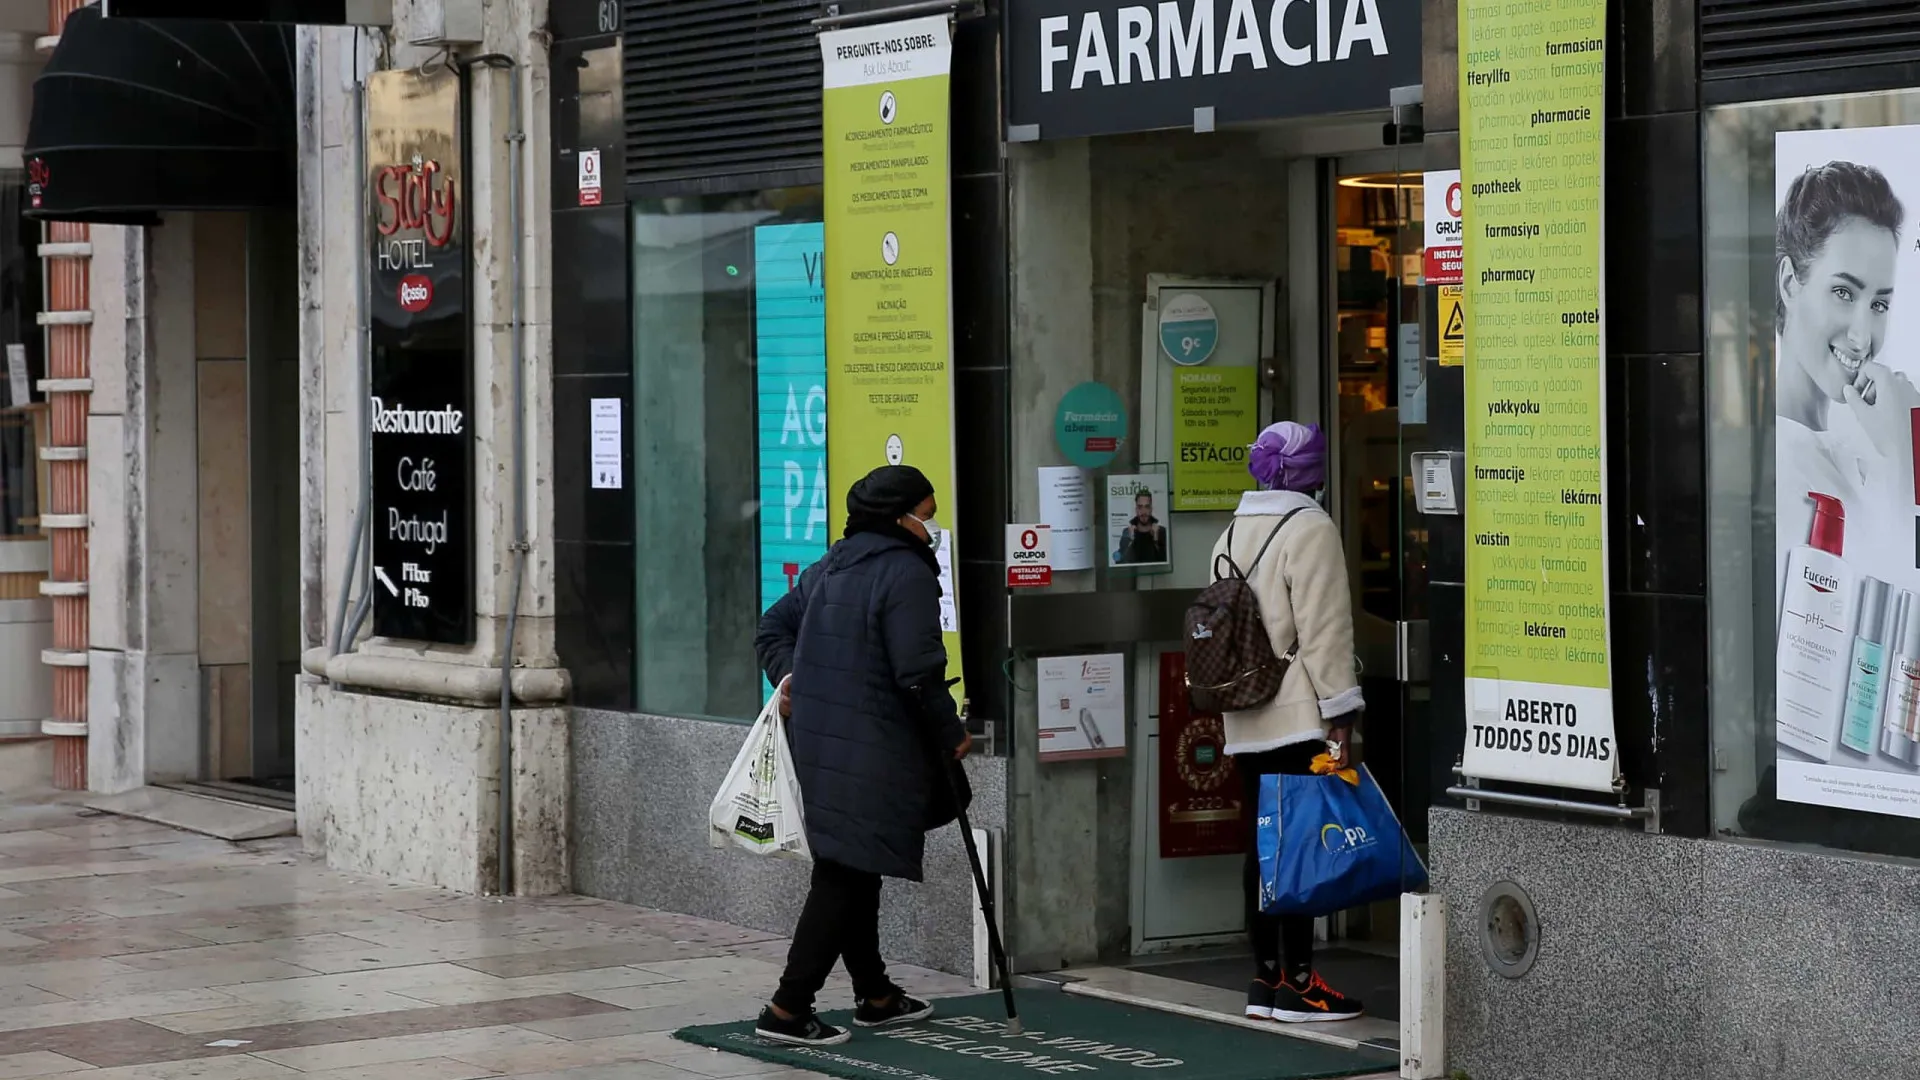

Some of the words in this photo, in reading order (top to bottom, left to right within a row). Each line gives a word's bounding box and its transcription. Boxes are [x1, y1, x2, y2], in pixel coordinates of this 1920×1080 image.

[599, 0, 618, 32] 60
[836, 38, 903, 60] PERGUNTE-NOS
[904, 33, 936, 51] SOBRE:
[1467, 48, 1501, 66] apteek
[1545, 37, 1603, 56] farmasian
[863, 61, 875, 77] Ask
[876, 60, 886, 75] Us
[1467, 68, 1510, 87] fferyllfa
[1531, 105, 1591, 128] pharmacie
[1513, 132, 1552, 148] farmasi
[1472, 177, 1522, 199] apotheek
[1485, 222, 1540, 240] farmasiya
[378, 239, 433, 270] HOTEL
[1481, 267, 1535, 286] pharmacy
[1515, 288, 1553, 303] farmasi
[1561, 308, 1600, 328] apotek
[371, 396, 463, 434] Restaurante
[1487, 399, 1540, 417] yakkyoku
[1485, 421, 1535, 439] pharmacy
[1180, 443, 1245, 462] ESTÁCIO
[398, 456, 436, 491] Café
[1474, 465, 1525, 484] farmacije
[1544, 510, 1585, 529] fferyllfa
[388, 507, 447, 555] Portugal
[1474, 531, 1510, 547] vaistin
[1011, 566, 1048, 575] INSTALAÇÃO
[1541, 555, 1587, 572] farmácia
[1487, 576, 1536, 595] pharmacy
[1803, 565, 1838, 590] Eucerin
[1524, 621, 1566, 639] lekáren
[1805, 613, 1825, 630] pH5
[1565, 646, 1605, 664] lékárna
[1857, 657, 1879, 673] Eucerin
[1505, 698, 1577, 727] ABERTO
[1473, 725, 1532, 750] TODOS
[1538, 732, 1562, 756] OS
[1566, 734, 1611, 761] DIAS
[873, 1026, 1099, 1074] WELCOME
